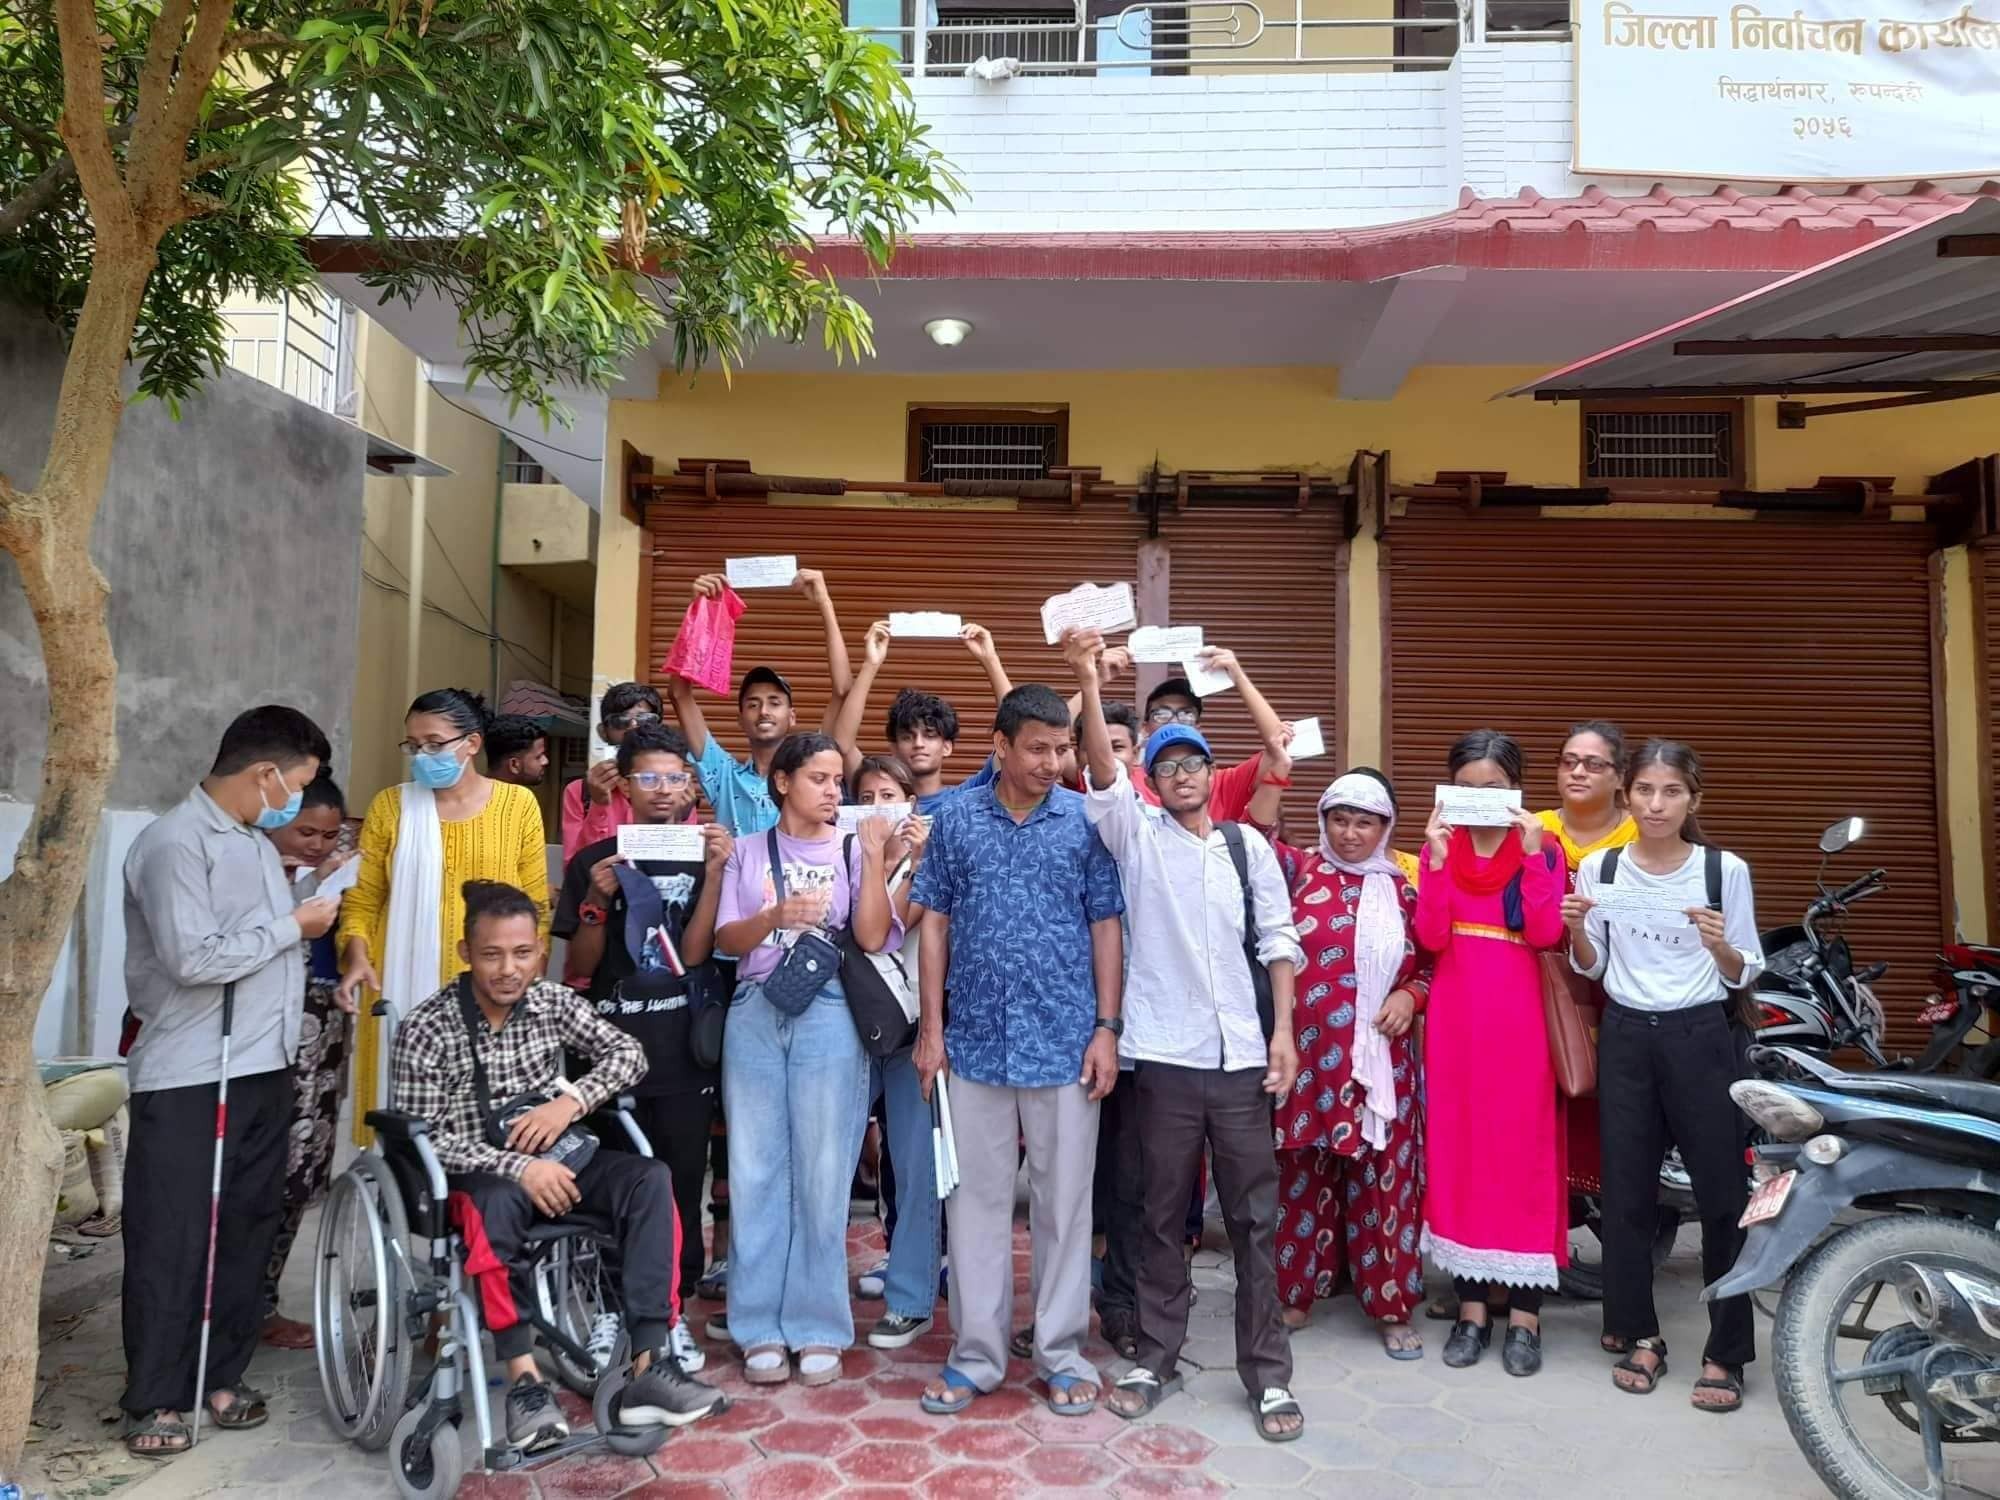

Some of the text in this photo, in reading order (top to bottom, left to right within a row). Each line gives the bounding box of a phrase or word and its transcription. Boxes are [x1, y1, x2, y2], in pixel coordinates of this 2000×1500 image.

[1603, 1, 1718, 50] जिल्ला
[1730, 3, 1866, 55] निर्वाचन
[1631, 927, 1681, 945] PARIS
